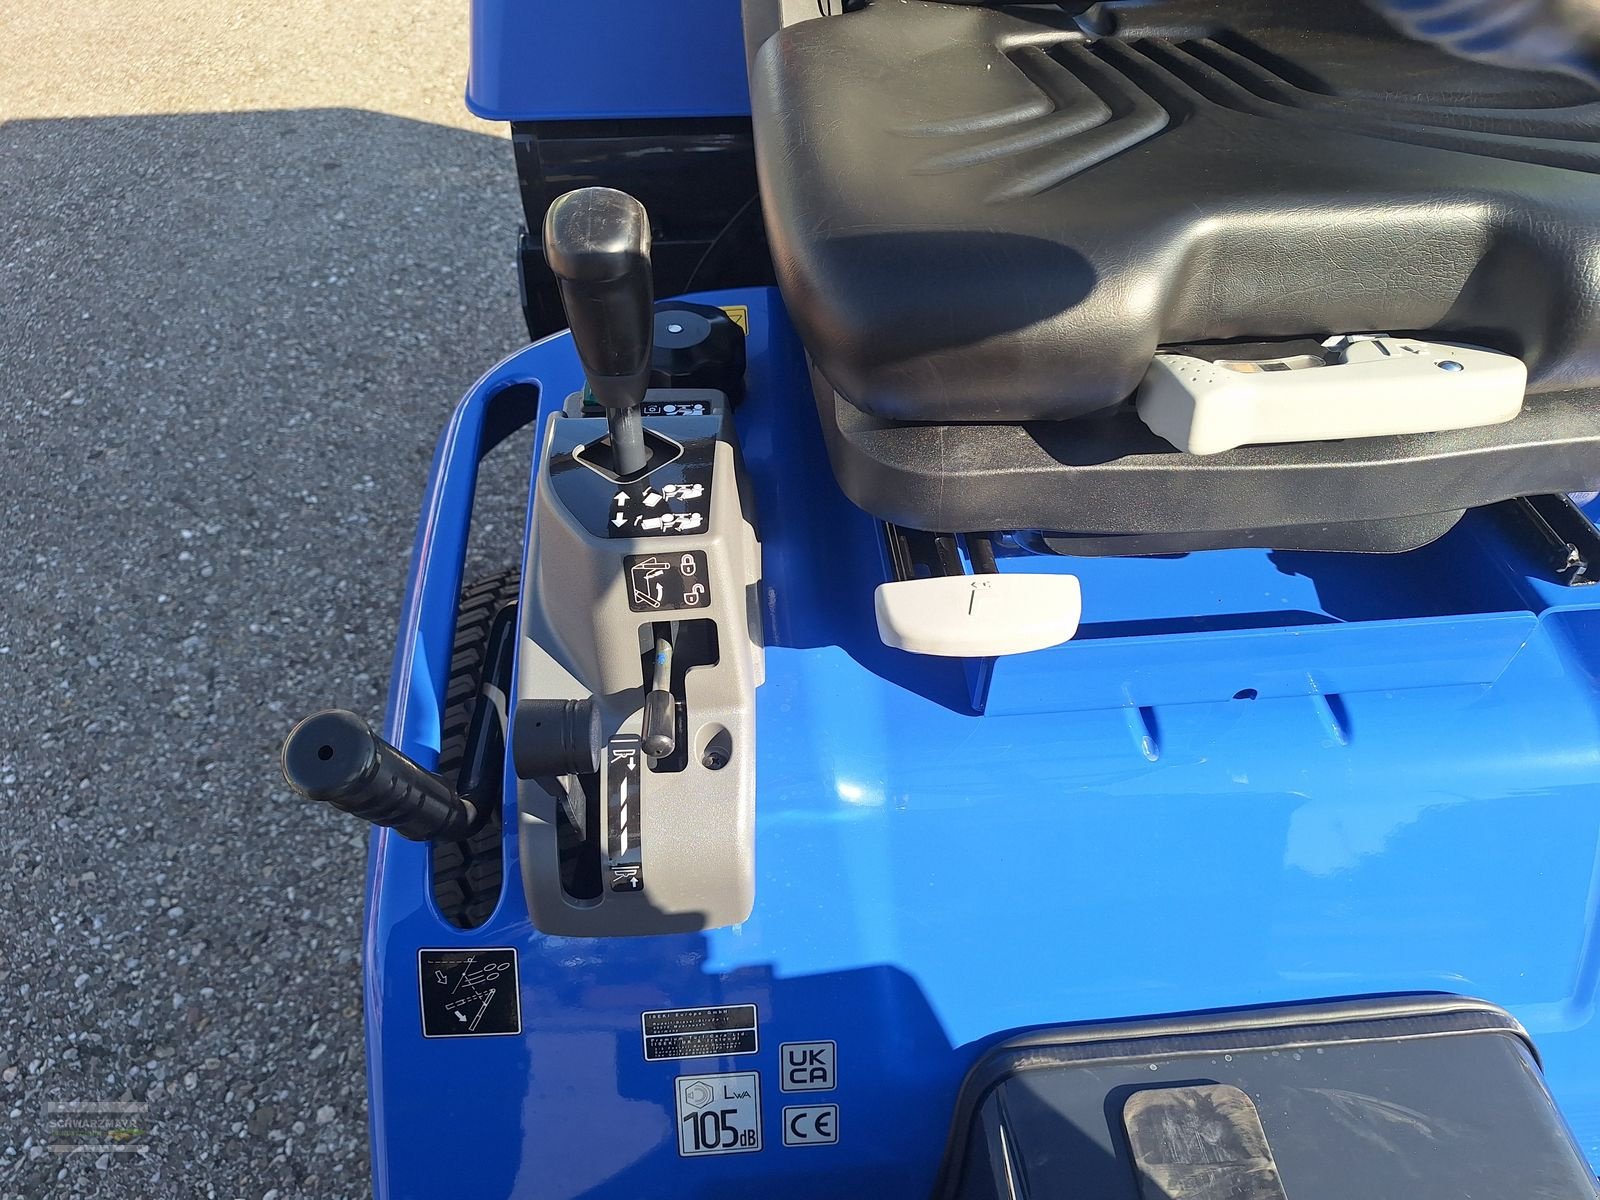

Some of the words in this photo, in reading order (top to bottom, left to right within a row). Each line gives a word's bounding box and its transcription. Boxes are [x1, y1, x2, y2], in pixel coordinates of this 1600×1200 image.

[789, 1049, 826, 1066] UK
[789, 1067, 827, 1084] CA
[790, 1111, 832, 1139] CE
